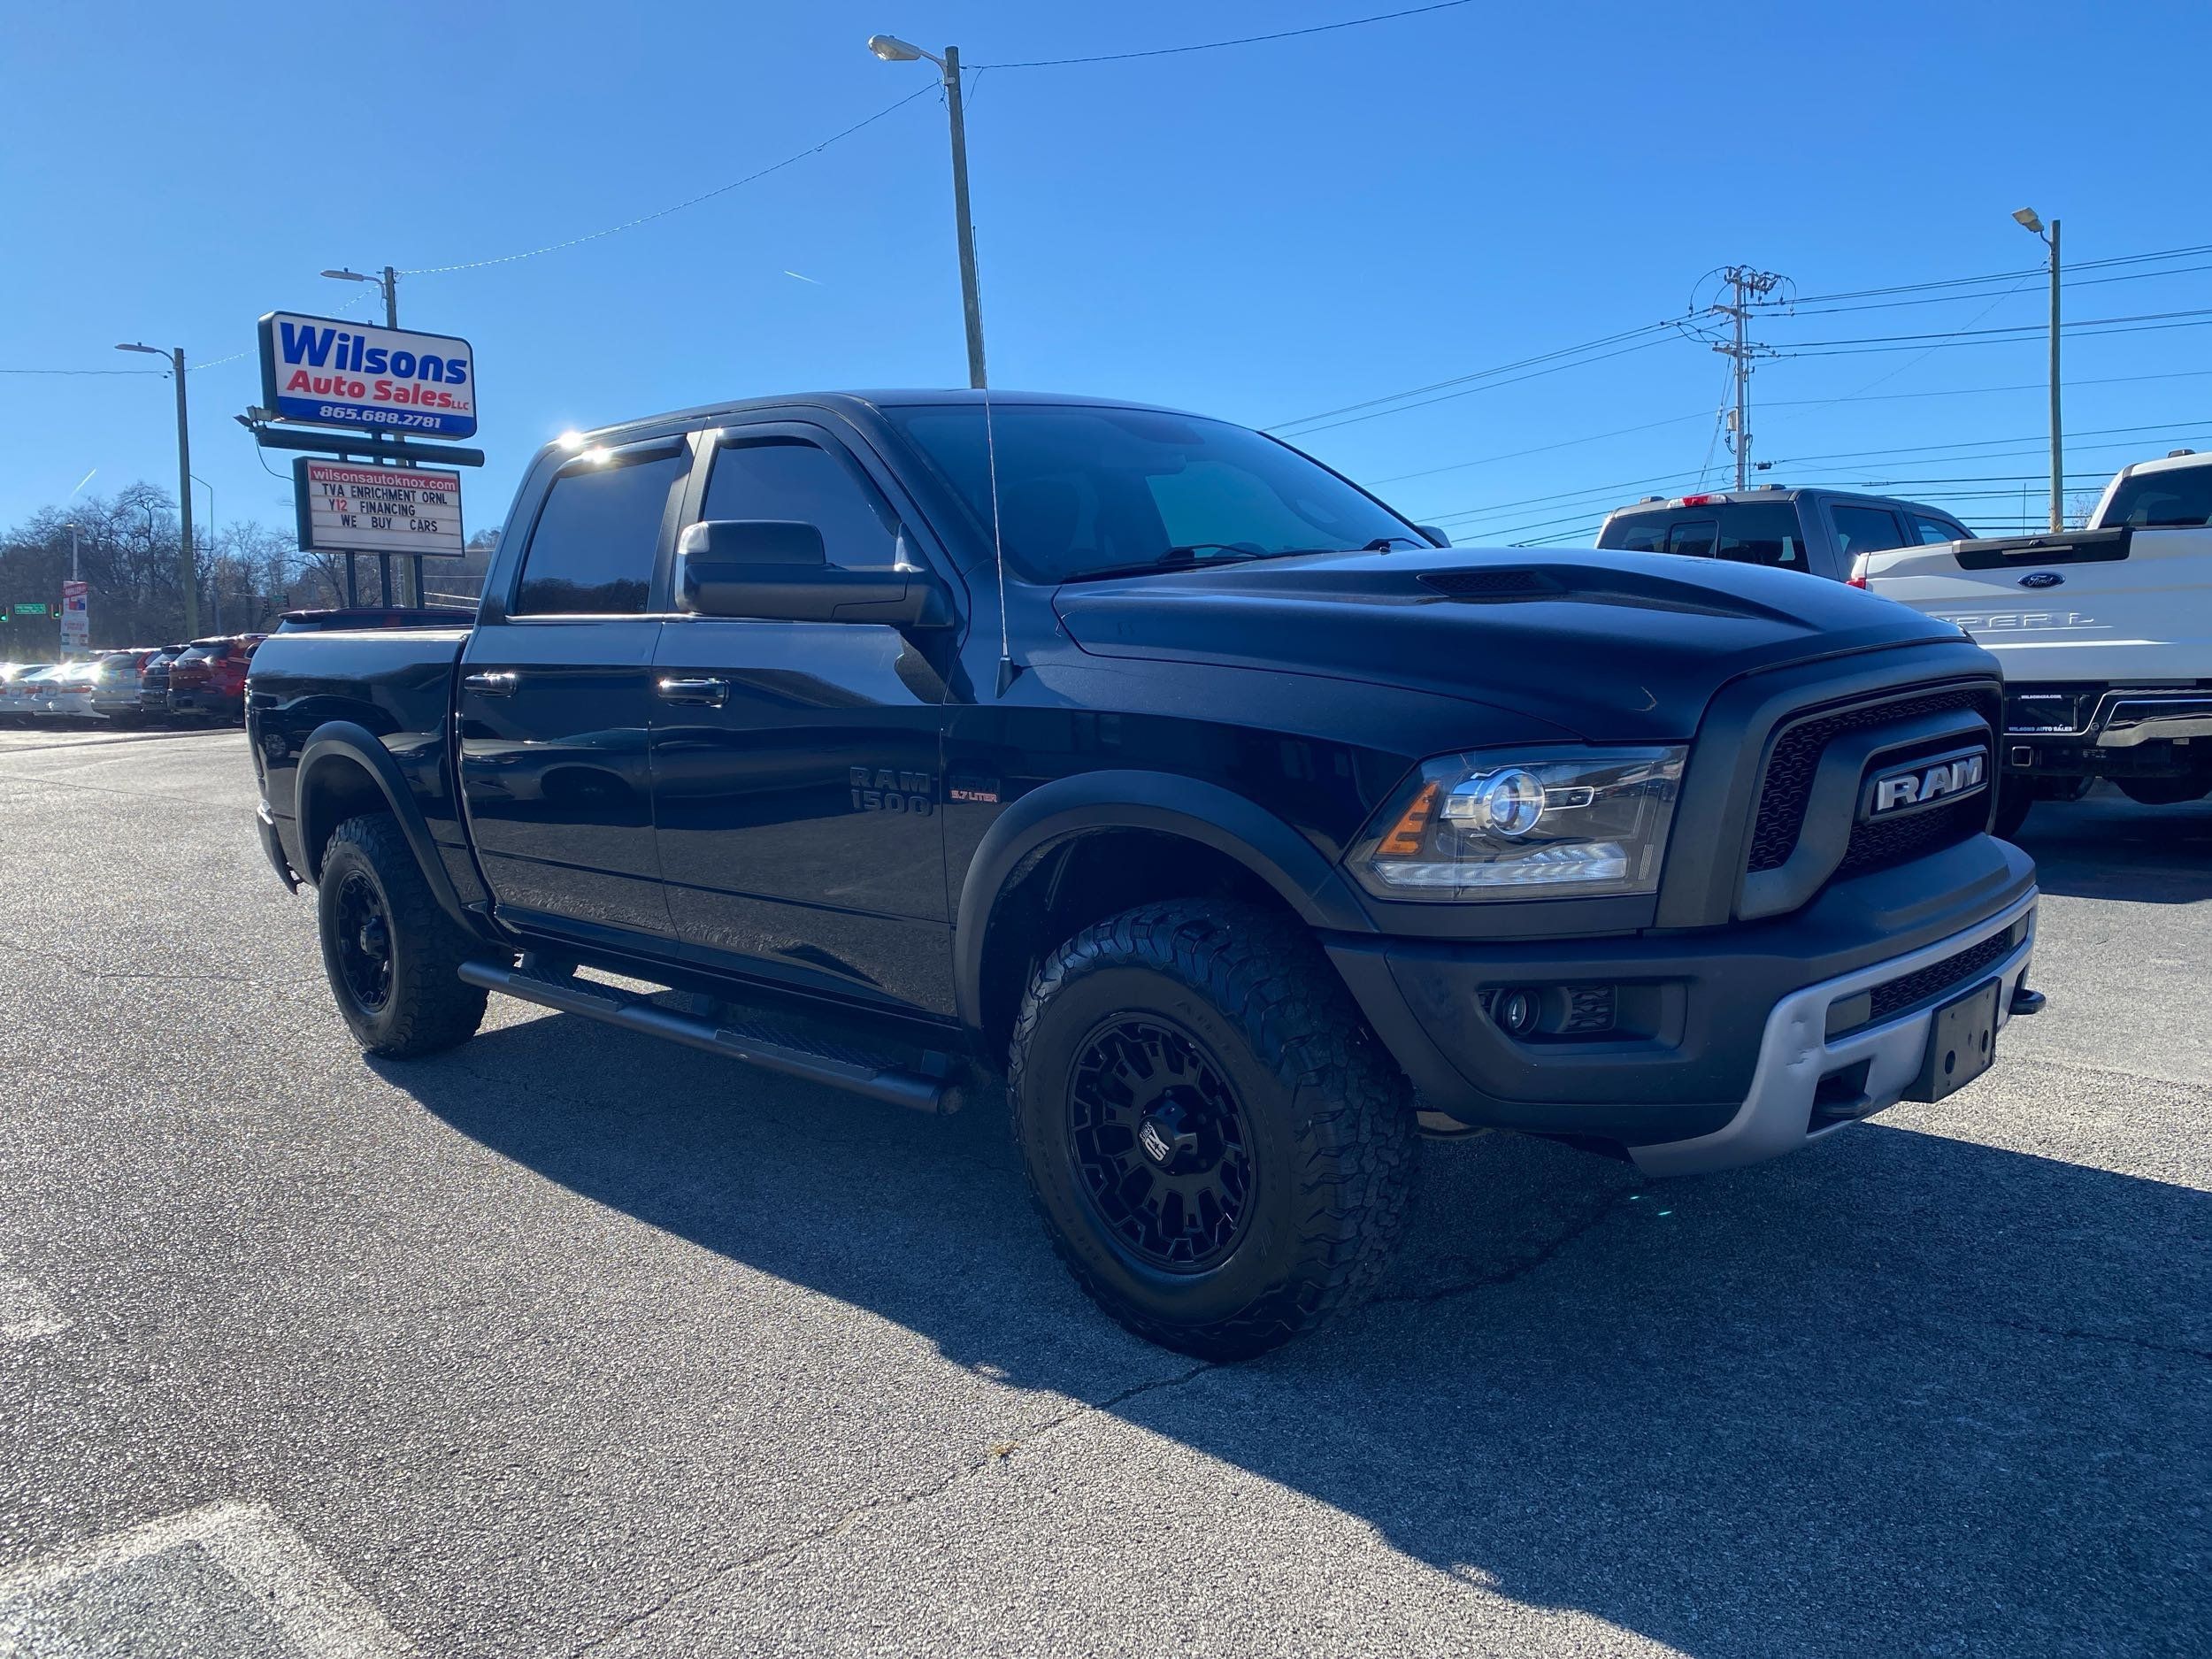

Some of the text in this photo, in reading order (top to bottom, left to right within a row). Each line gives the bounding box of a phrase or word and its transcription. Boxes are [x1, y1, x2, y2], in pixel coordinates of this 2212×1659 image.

[280, 322, 468, 384] Wilsons
[287, 370, 469, 411] Auto Sales LLC
[319, 405, 441, 428] 865.688.2781
[313, 469, 456, 491] wilsonsautoknox.com
[322, 483, 447, 504] TVA ENRICHMENT ORNL
[328, 499, 416, 516] Y12 FINANCING
[341, 514, 438, 532] WE BUY CARS
[849, 766, 930, 793] RAM
[1877, 755, 1983, 810] RAM
[850, 789, 933, 817] 1500
[950, 789, 998, 803] 5.7 LITER
